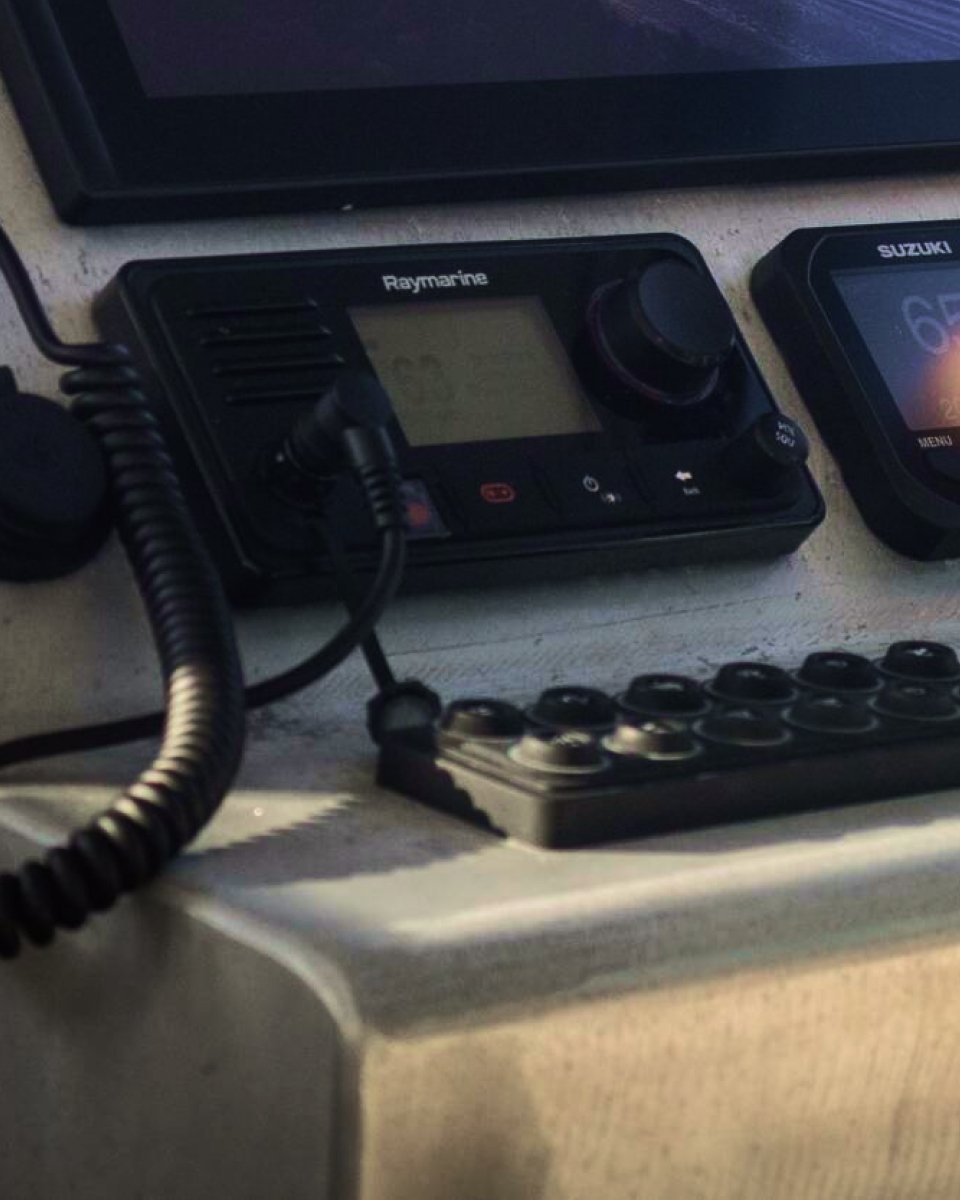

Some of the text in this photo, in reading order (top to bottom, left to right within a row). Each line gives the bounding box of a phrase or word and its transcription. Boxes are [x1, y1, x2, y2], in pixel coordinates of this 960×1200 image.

[877, 240, 952, 258] SUZUKI
[383, 270, 489, 293] Raymarine
[918, 436, 952, 448] MENU
